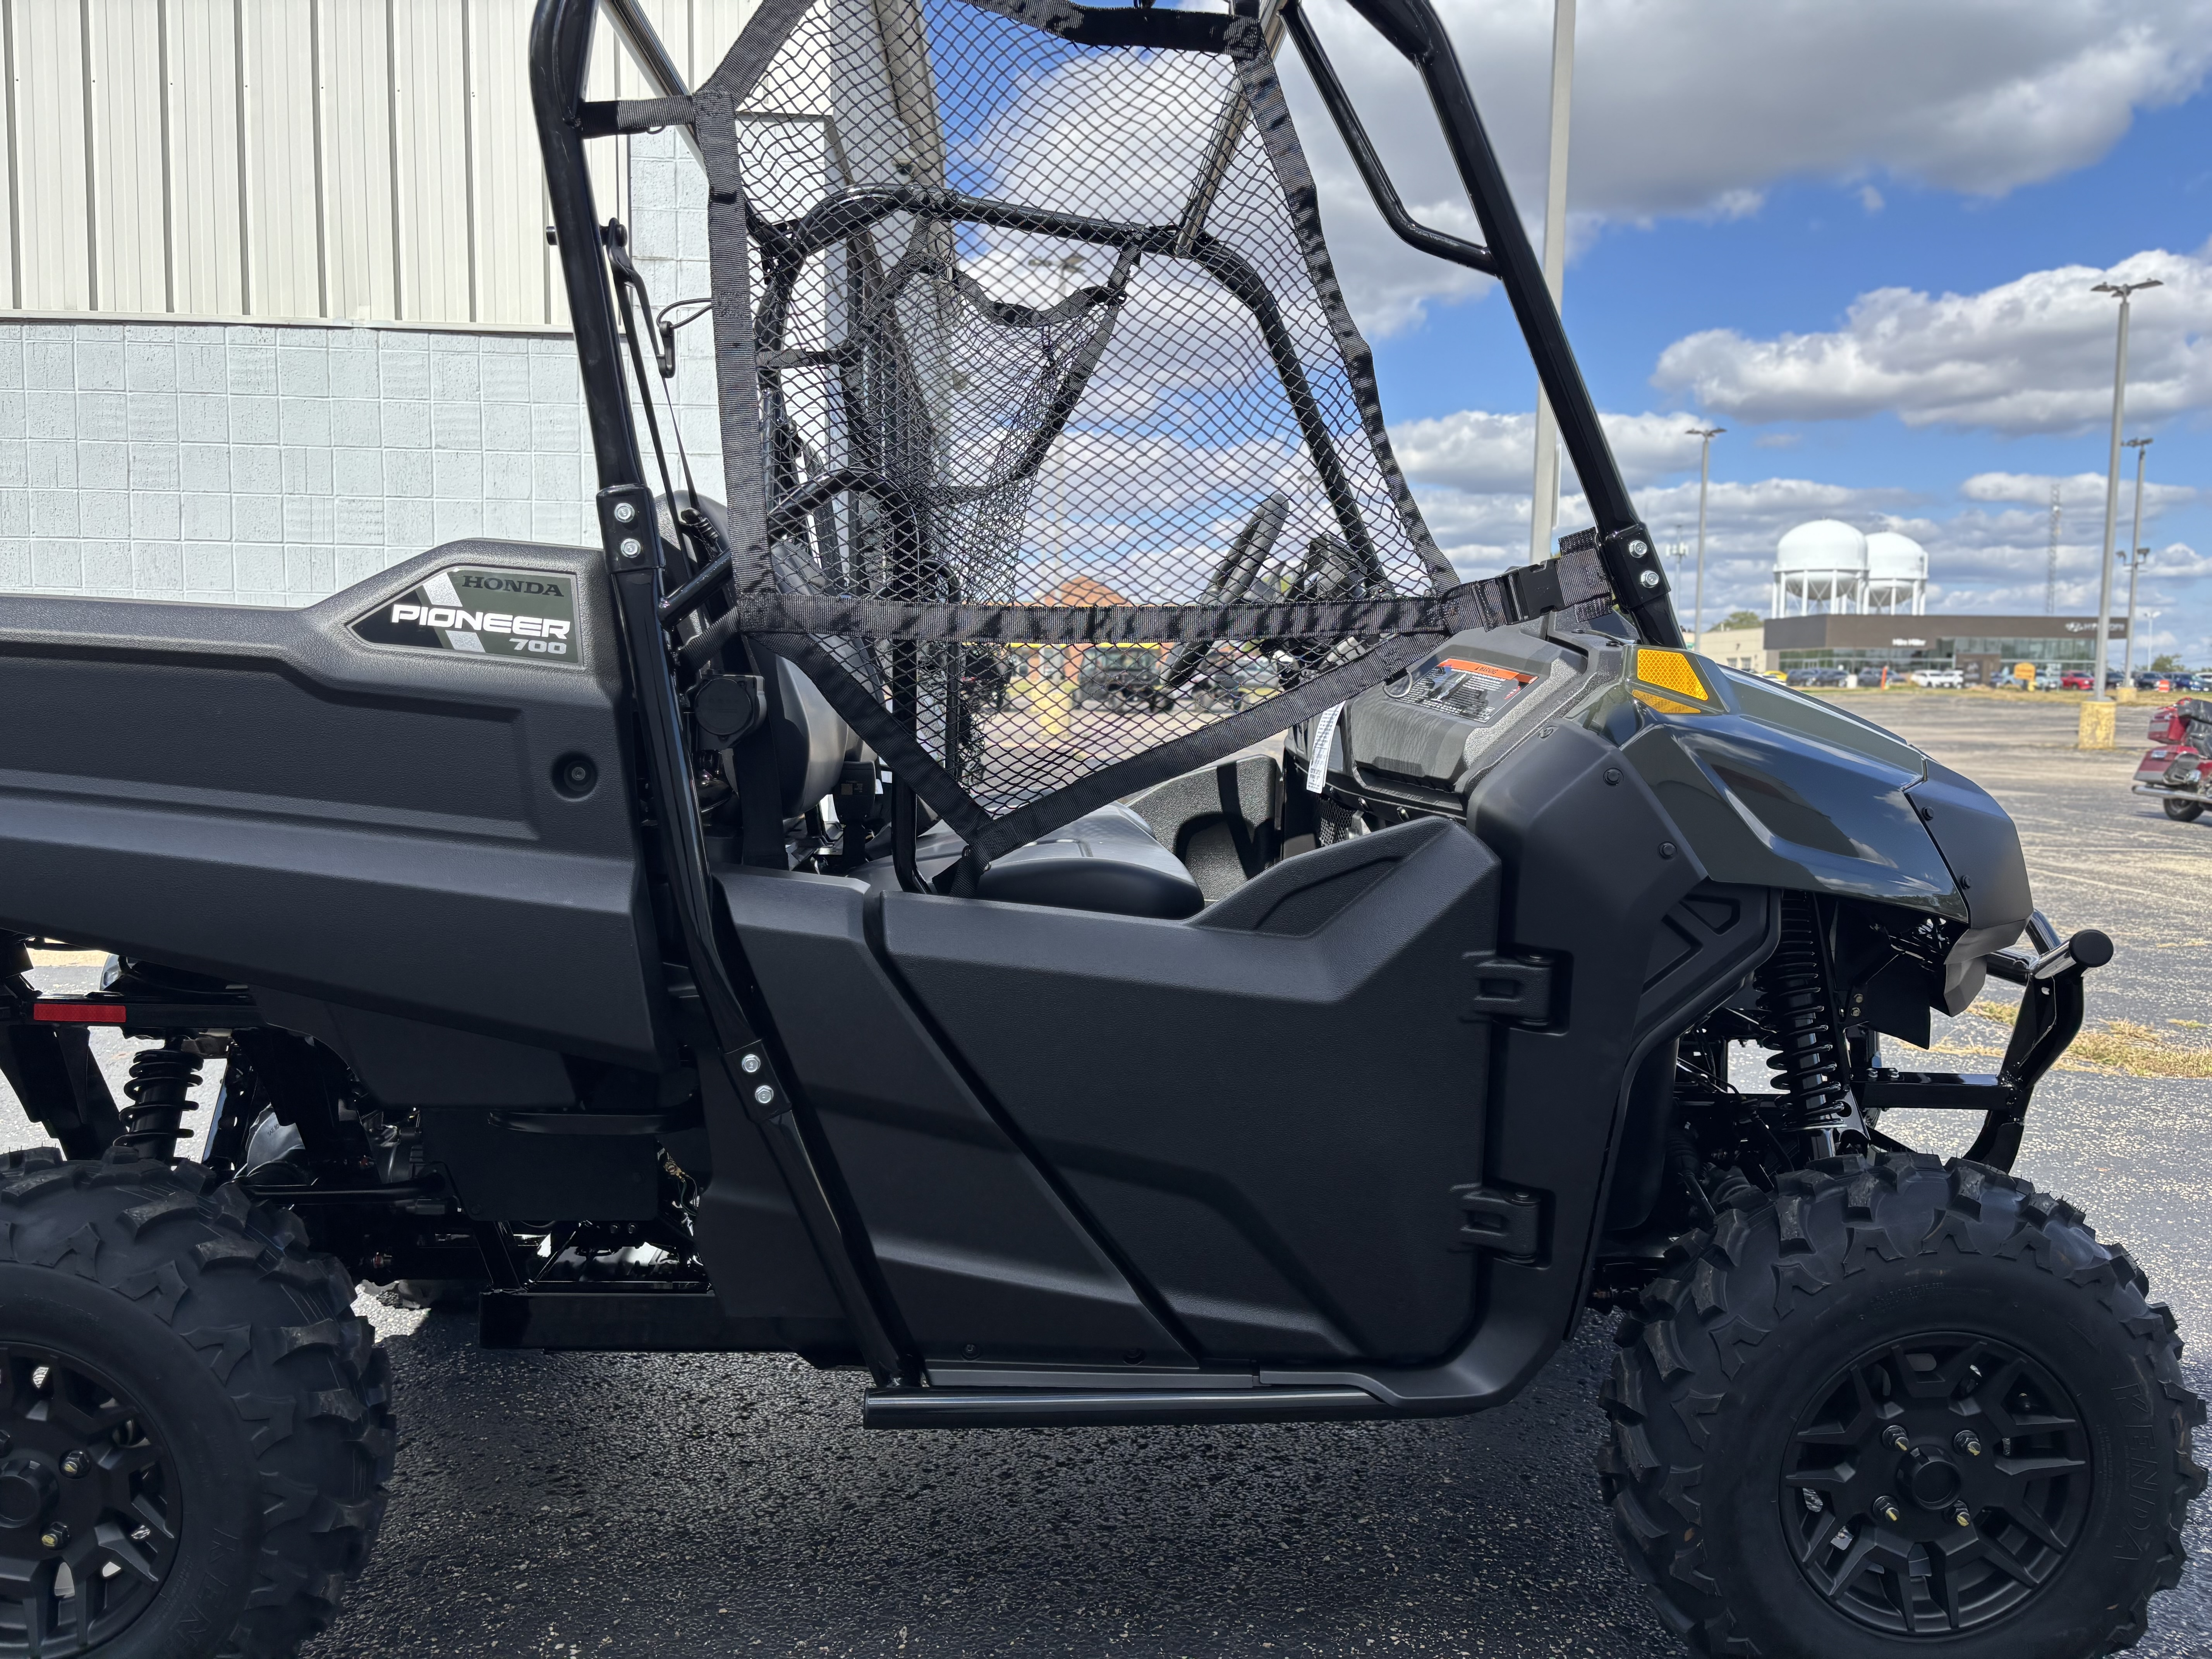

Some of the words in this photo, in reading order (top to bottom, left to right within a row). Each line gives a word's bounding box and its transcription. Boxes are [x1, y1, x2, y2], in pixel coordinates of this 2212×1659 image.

[462, 575, 564, 597] HONDA
[392, 604, 570, 639] PIONEER
[509, 638, 567, 654] 700
[2110, 1383, 2158, 1560] KENDA
